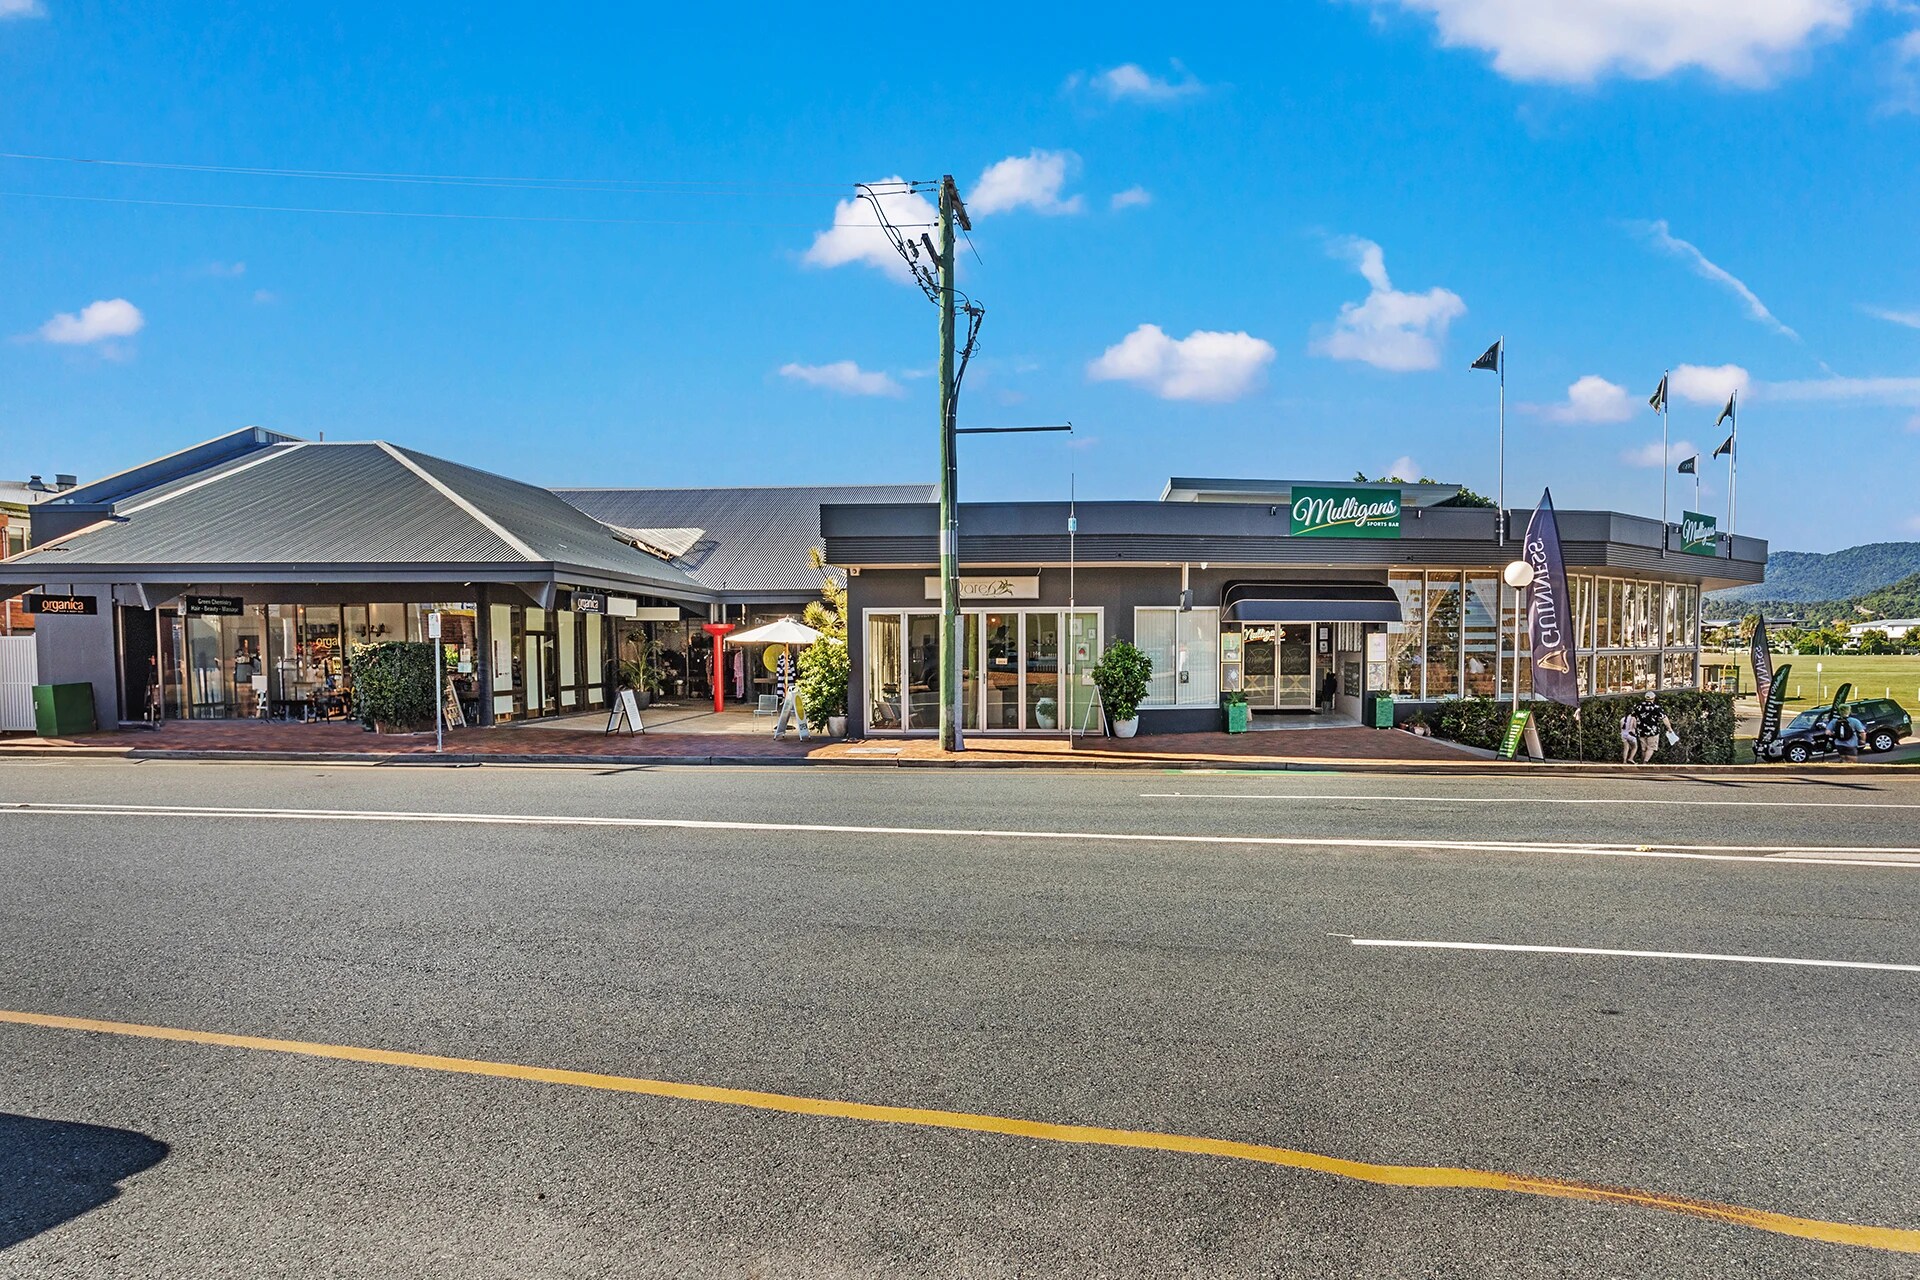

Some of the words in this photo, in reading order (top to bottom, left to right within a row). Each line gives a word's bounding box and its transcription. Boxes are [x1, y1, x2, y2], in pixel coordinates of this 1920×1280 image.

[1292, 496, 1397, 528] Mulligans
[1682, 519, 1716, 546] Mulligans
[42, 597, 84, 612] organica
[577, 595, 599, 611] organica
[1243, 628, 1287, 642] Mulligas
